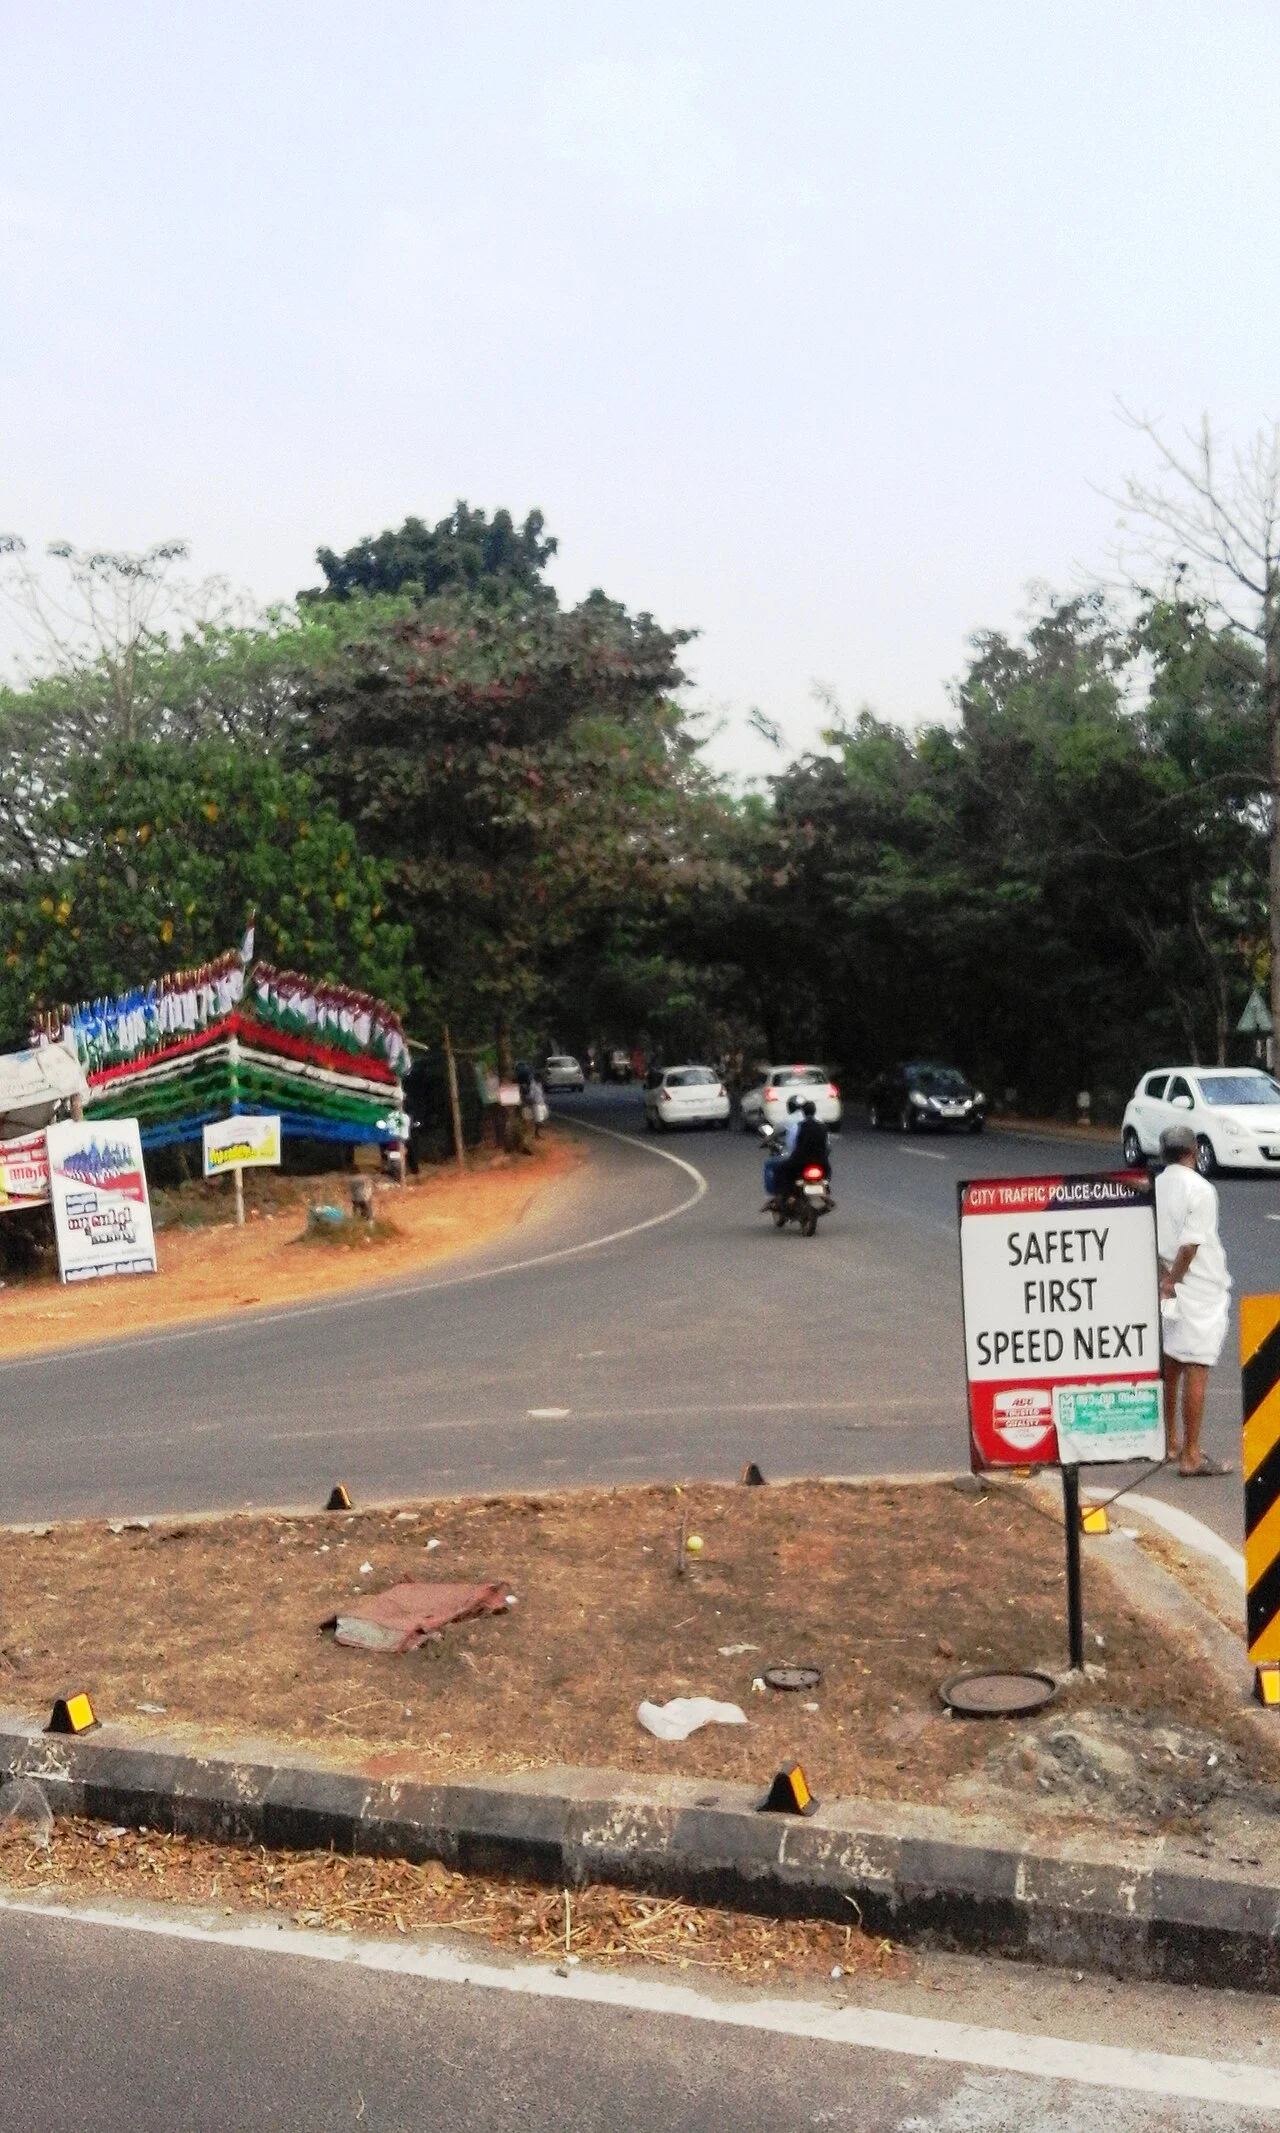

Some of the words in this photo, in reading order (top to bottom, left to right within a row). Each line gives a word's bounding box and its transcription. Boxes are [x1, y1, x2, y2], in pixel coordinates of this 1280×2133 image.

[970, 1190, 994, 1206] CITY
[1000, 1187, 1045, 1204] TRAFFIC
[1007, 1228, 1109, 1266] SAFETY
[1024, 1277, 1097, 1314] FIRST
[976, 1328, 1064, 1366] SPEED
[1073, 1323, 1147, 1360] NEXT
